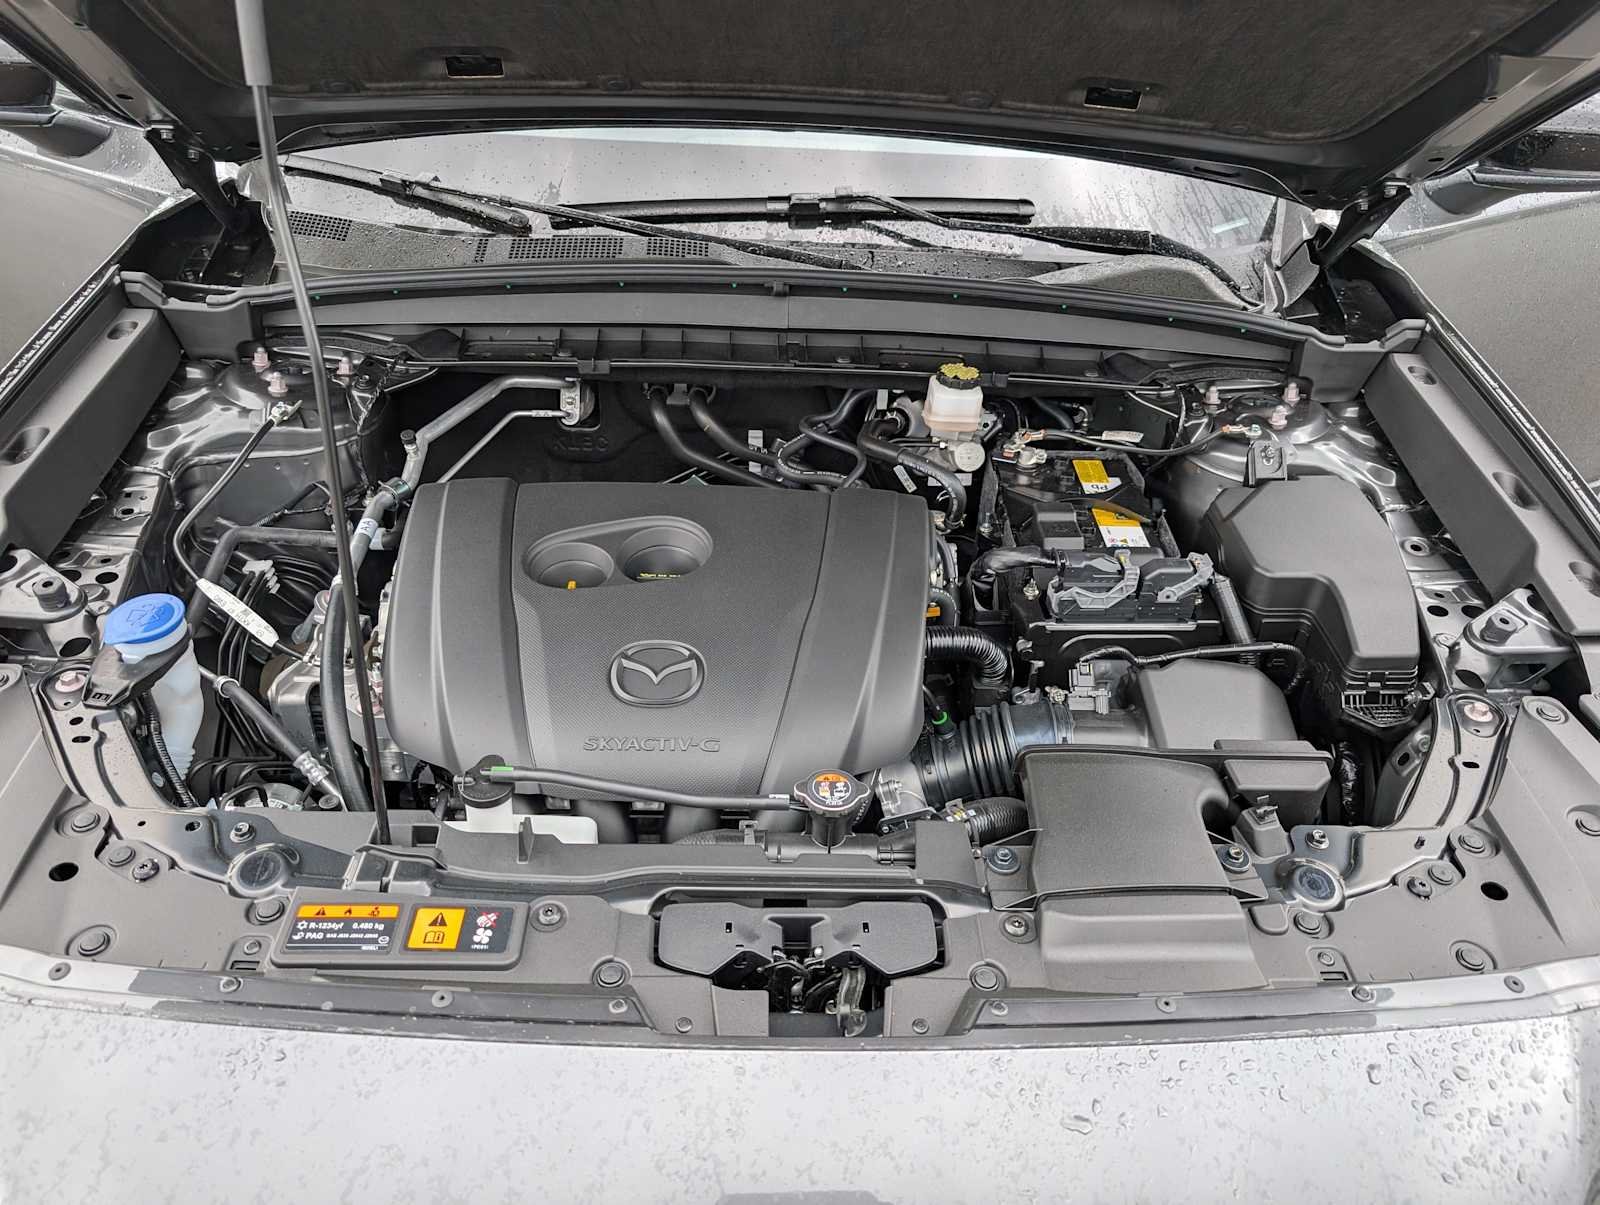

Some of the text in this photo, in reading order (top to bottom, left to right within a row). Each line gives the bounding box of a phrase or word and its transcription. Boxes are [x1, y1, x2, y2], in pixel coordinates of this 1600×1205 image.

[583, 735, 721, 753] SKYACTIV-G
[308, 922, 344, 931] R-1234yf
[374, 922, 385, 931] kg
[305, 932, 324, 940] PAG
